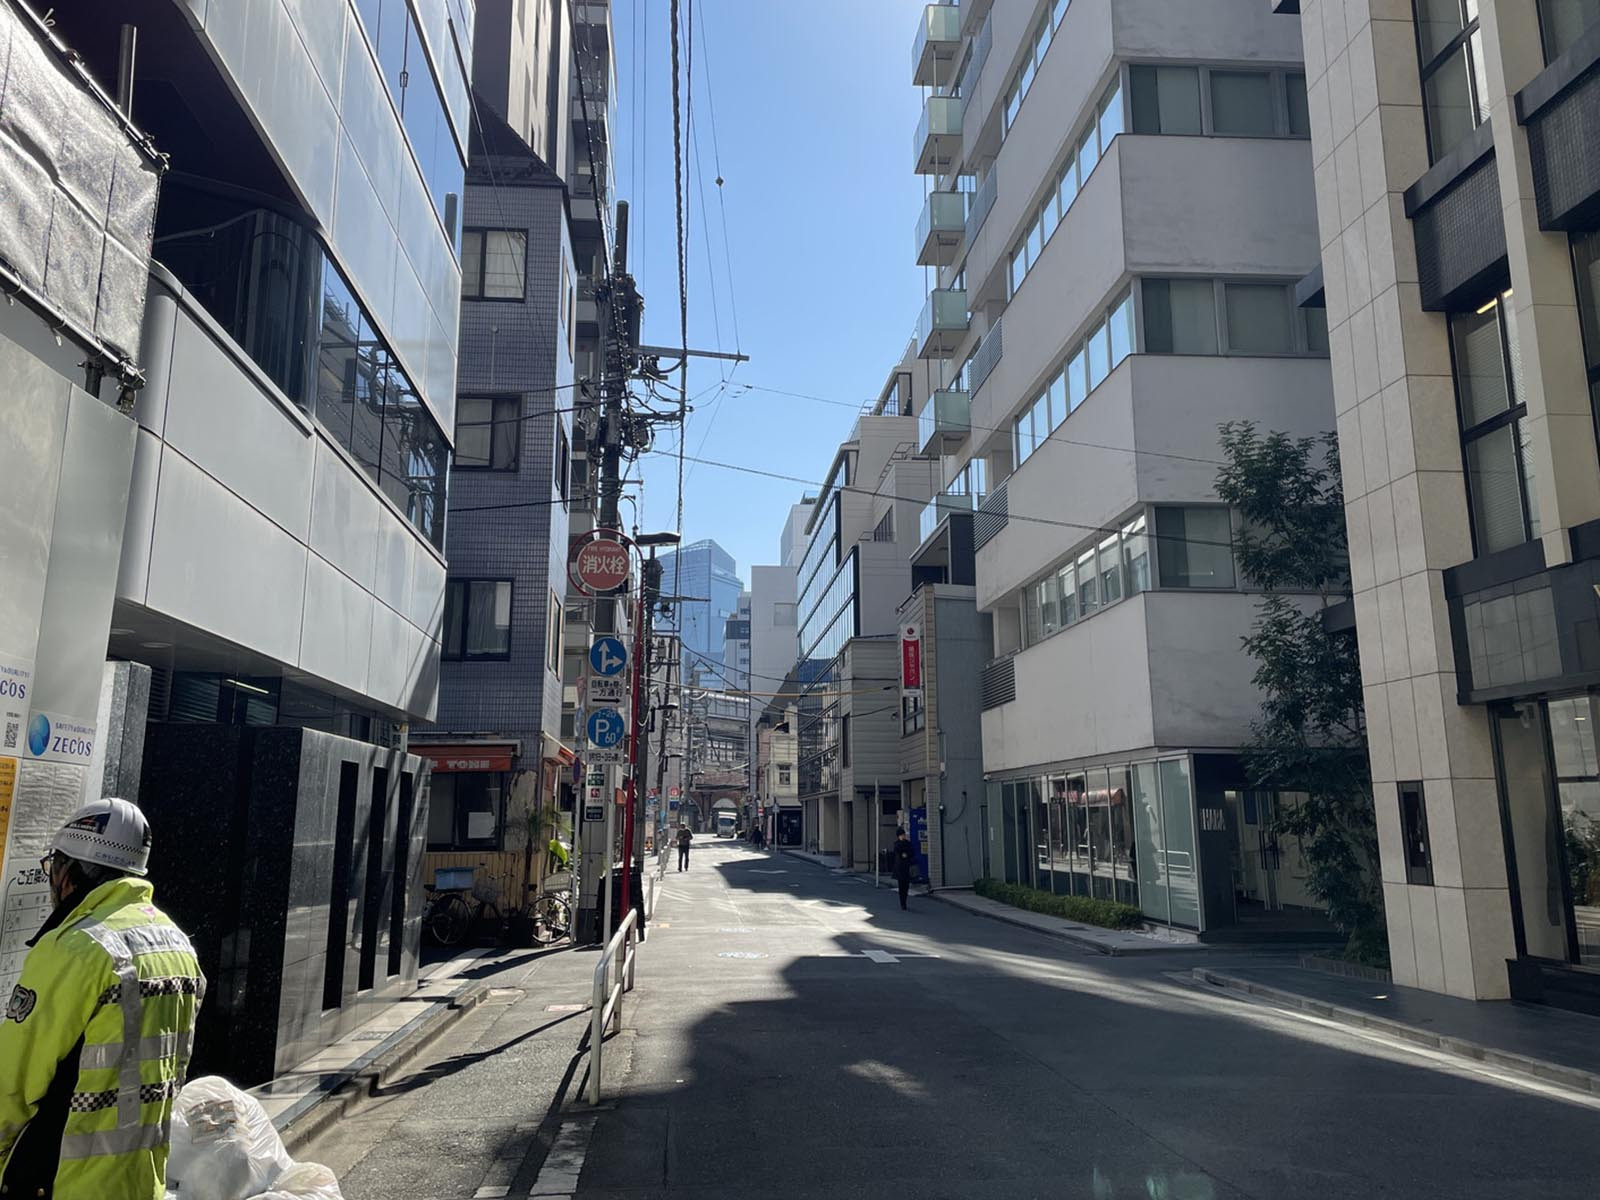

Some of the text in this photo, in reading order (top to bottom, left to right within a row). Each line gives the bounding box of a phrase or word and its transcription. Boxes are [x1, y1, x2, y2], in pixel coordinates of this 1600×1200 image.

[582, 554, 626, 575] 消火栓
[591, 688, 624, 697] 一方通行
[52, 736, 92, 757] ZECOS
[446, 759, 490, 769] TONE
